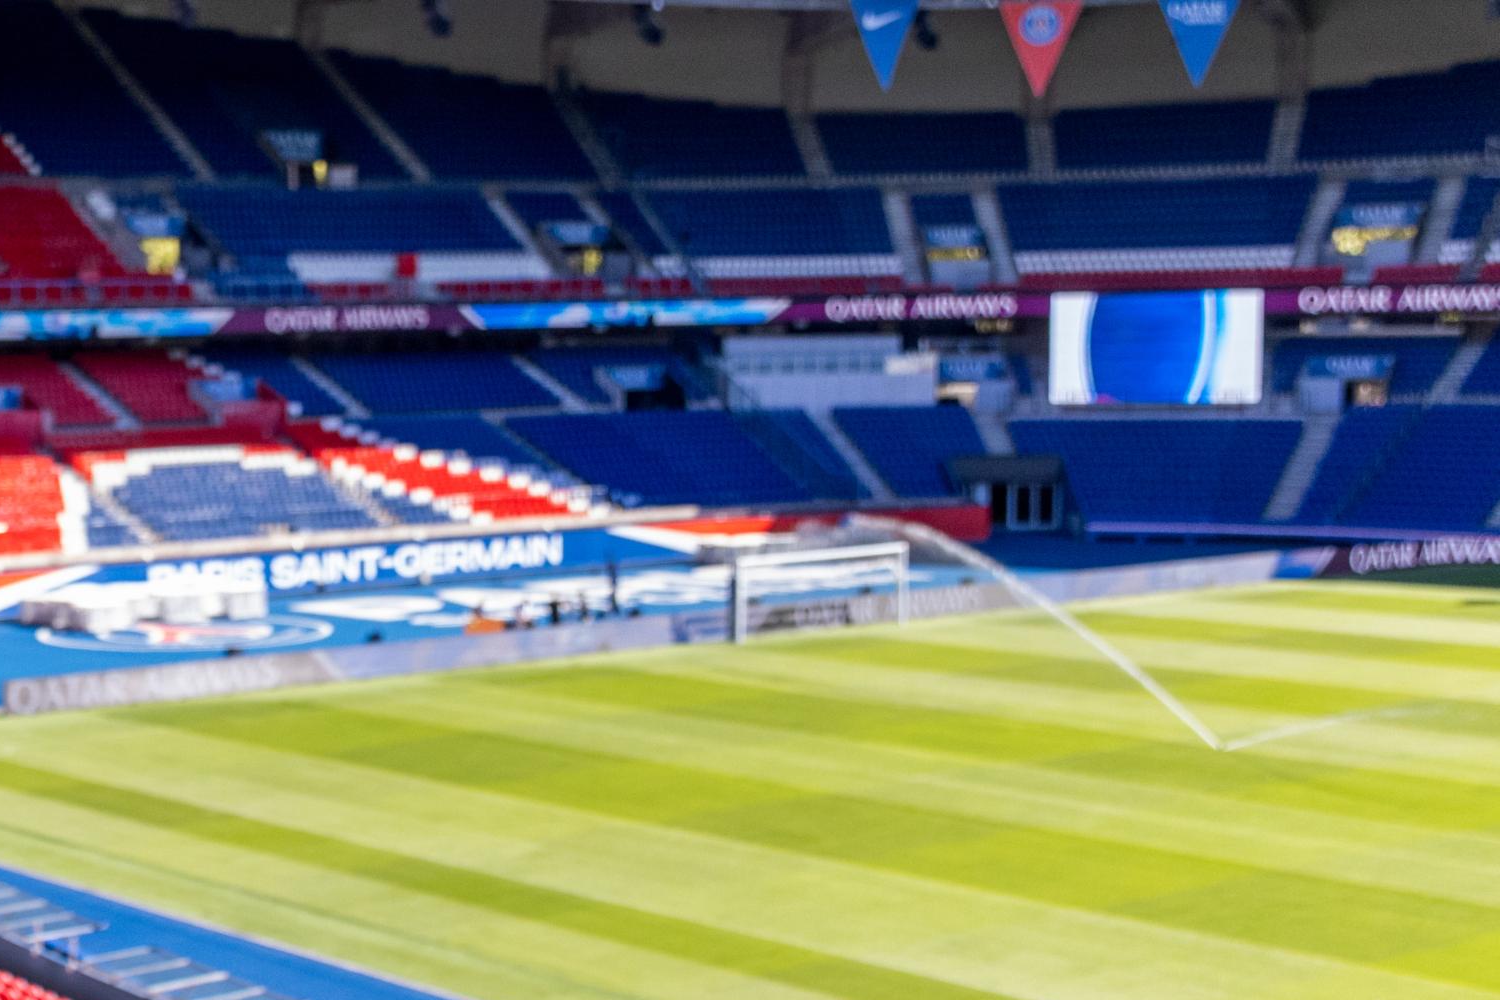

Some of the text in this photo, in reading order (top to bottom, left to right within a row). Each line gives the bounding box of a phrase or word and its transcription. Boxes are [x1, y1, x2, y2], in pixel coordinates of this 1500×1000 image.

[824, 293, 1018, 322] QATAR AIRWAYS
[1297, 285, 1393, 314] QATAR
[269, 533, 564, 589] SAINT-GERMAIN
